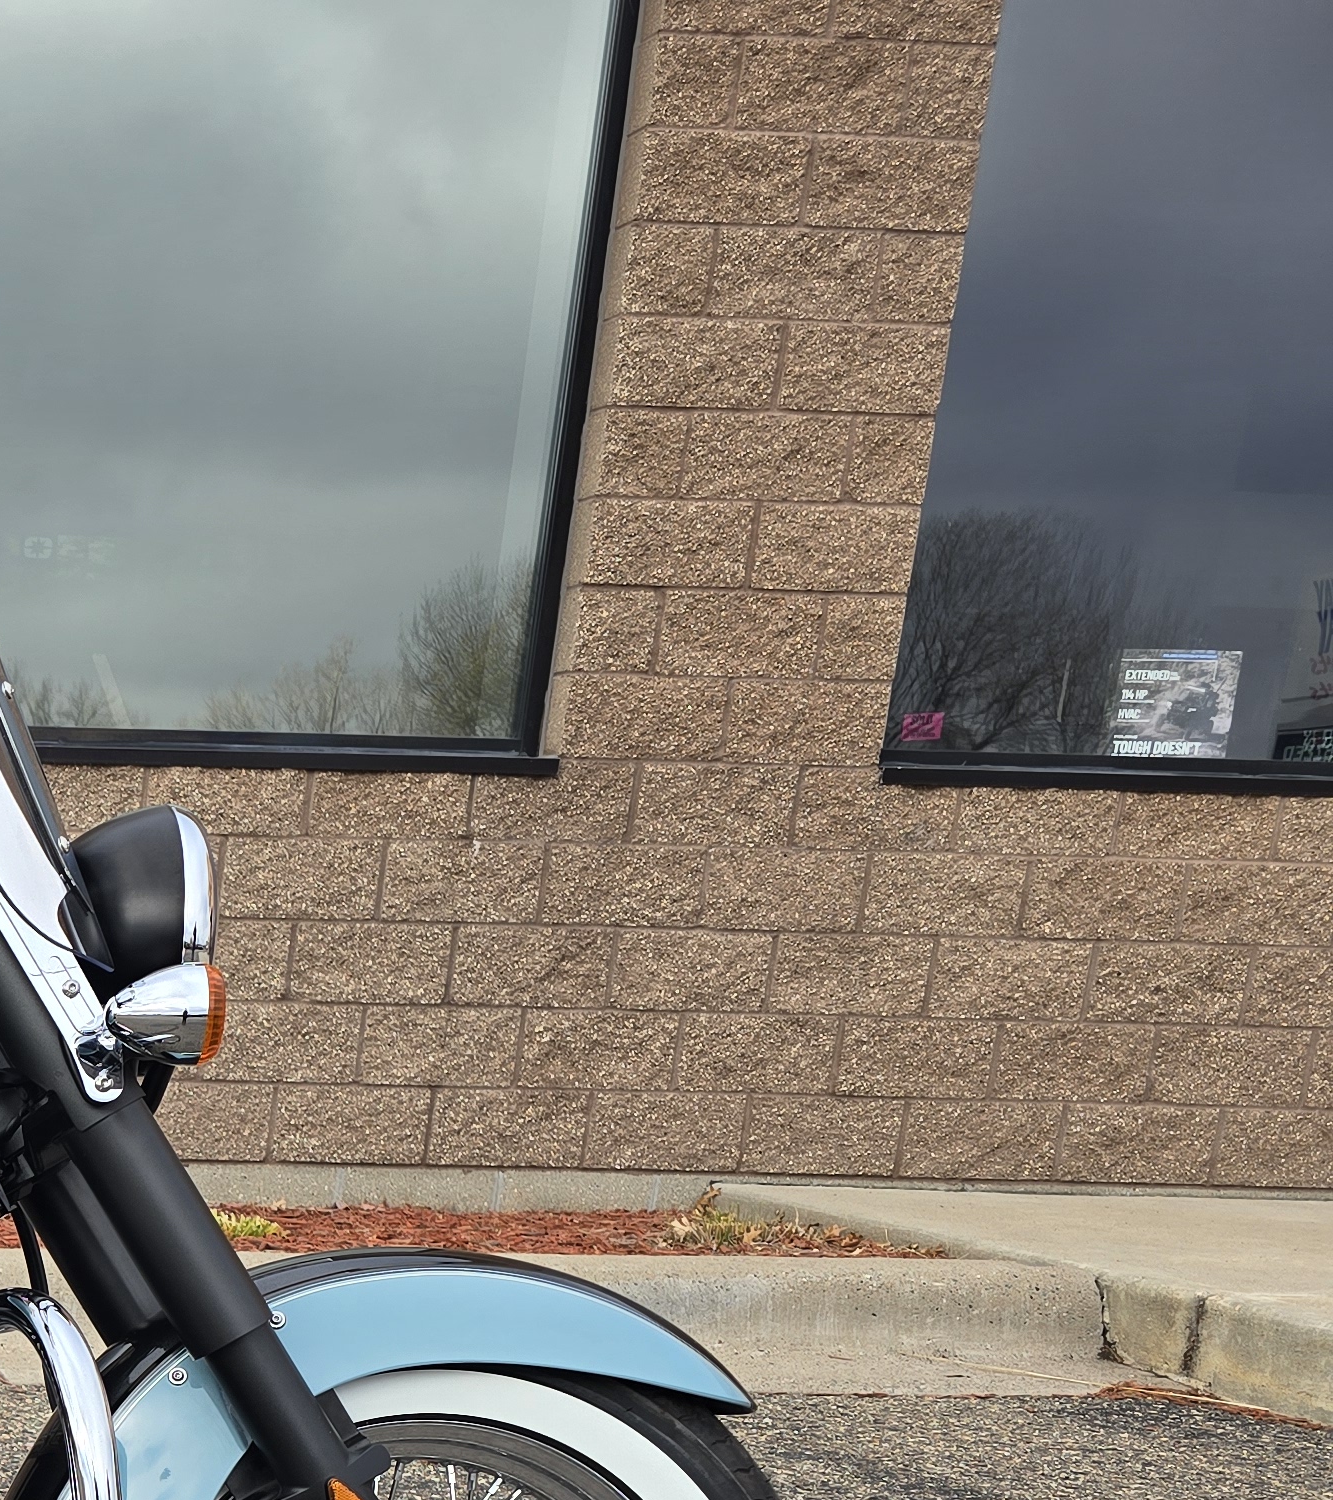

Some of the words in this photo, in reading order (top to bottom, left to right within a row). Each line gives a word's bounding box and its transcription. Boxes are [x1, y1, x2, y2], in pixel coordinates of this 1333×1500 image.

[1124, 670, 1171, 680] EXTENDED
[1121, 689, 1135, 700] 114
[1135, 689, 1149, 700] HP
[1118, 708, 1141, 719] HVAC
[1113, 741, 1153, 755] TOUGH
[1153, 741, 1202, 756] DOESN'T
